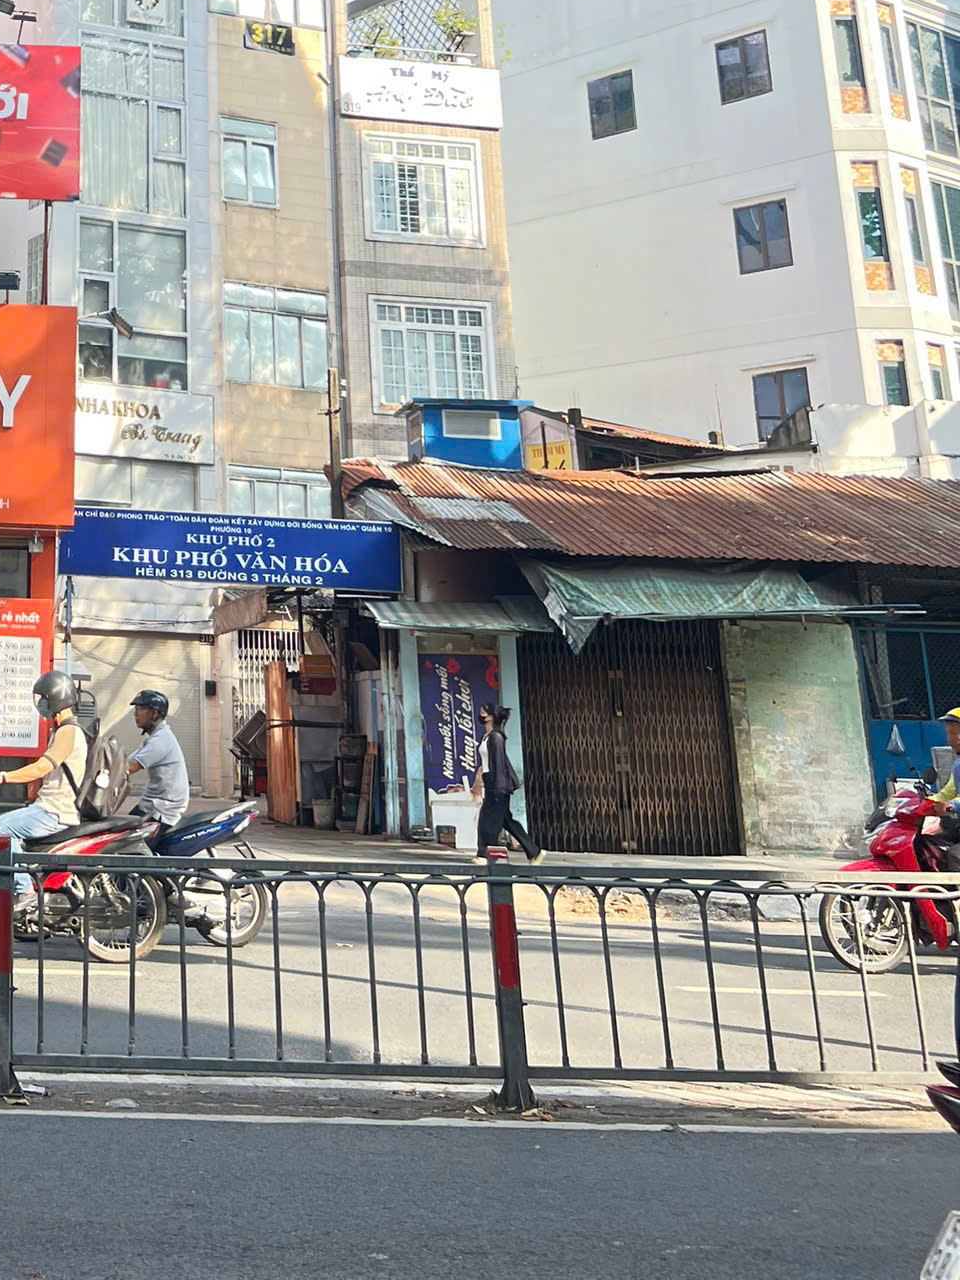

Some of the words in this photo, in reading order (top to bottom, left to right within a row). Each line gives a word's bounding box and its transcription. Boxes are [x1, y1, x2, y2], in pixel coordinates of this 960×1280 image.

[251, 23, 288, 46] 317
[343, 101, 361, 112] 319
[75, 397, 109, 415] NHA
[111, 400, 161, 421] KHOA
[151, 424, 203, 453] Trang
[117, 512, 143, 520] PHONG
[144, 512, 165, 521] TRÀO
[208, 515, 230, 525] ĐOÀN
[231, 516, 246, 526] KẾT
[247, 517, 263, 527] XÂY
[301, 520, 323, 529] SỐNG
[361, 524, 383, 533] QUẬN
[186, 533, 223, 545] KHU
[227, 534, 263, 547] PHỐ
[266, 537, 276, 548] 2
[112, 547, 169, 564] KHU
[175, 546, 228, 568] PHỐ
[235, 551, 288, 571] VĂN
[294, 552, 350, 574] HÓA
[135, 564, 167, 577] HẺM
[170, 569, 193, 579] 313
[197, 569, 248, 582] ĐƯỜNG
[251, 573, 259, 582] 3
[262, 572, 312, 585] THÁNG
[315, 576, 324, 585] 2
[2, 610, 13, 621] rẻ
[15, 610, 40, 624] nhất
[434, 663, 449, 690] mới
[458, 737, 480, 772] thay
